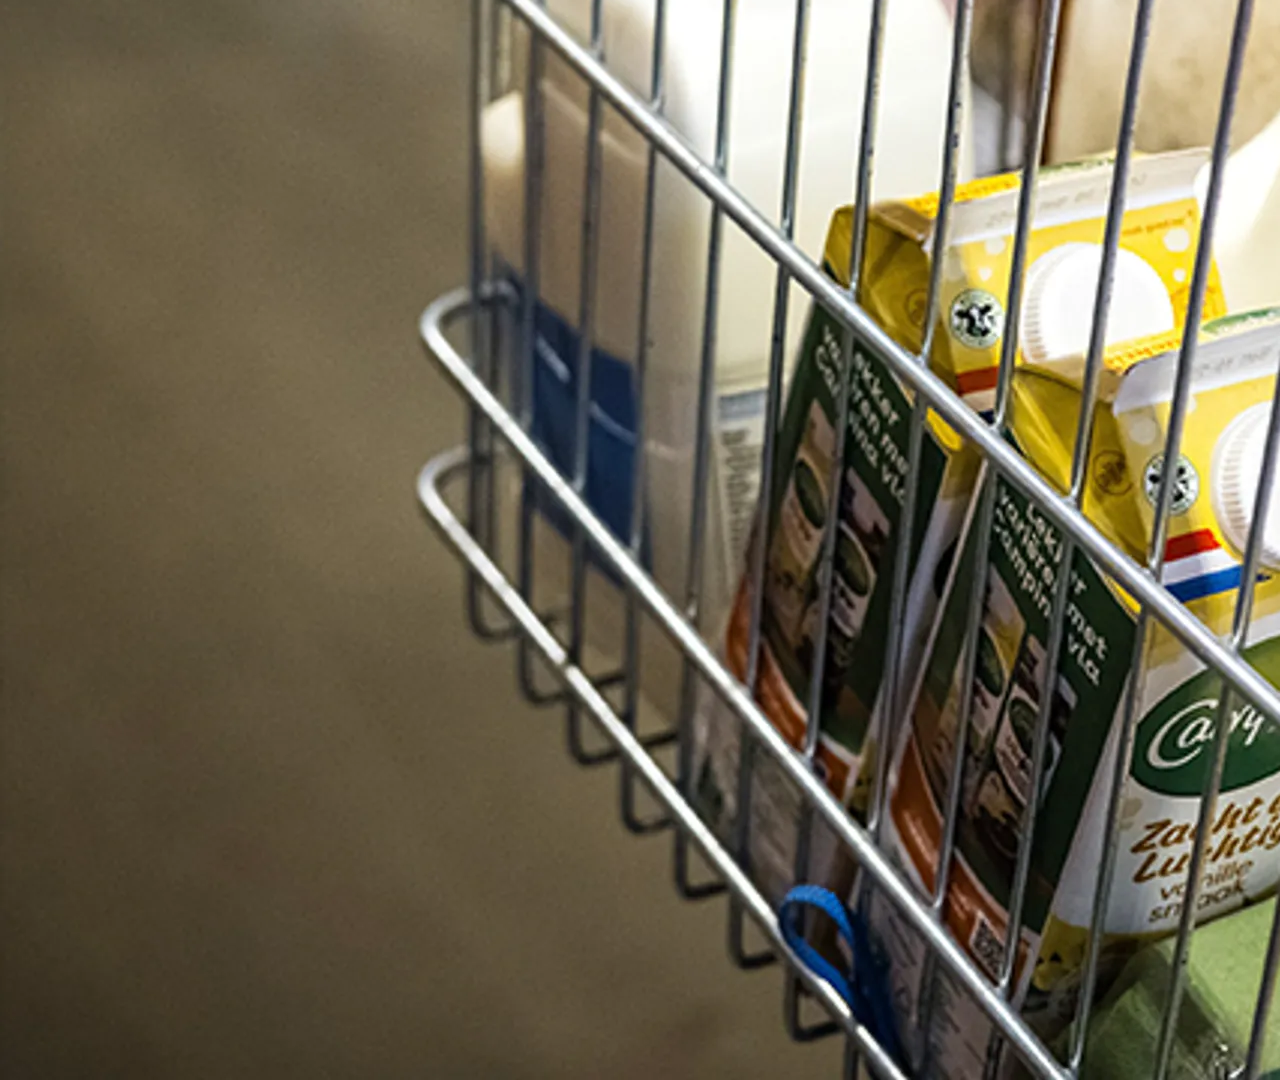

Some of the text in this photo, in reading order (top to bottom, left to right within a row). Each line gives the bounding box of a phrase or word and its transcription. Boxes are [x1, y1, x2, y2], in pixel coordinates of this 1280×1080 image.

[850, 350, 899, 426] ekker
[1025, 502, 1088, 596] Lekr
[993, 507, 1101, 687] ampin vla
[1066, 602, 1108, 661] met
[1130, 796, 1264, 854] Zaht
